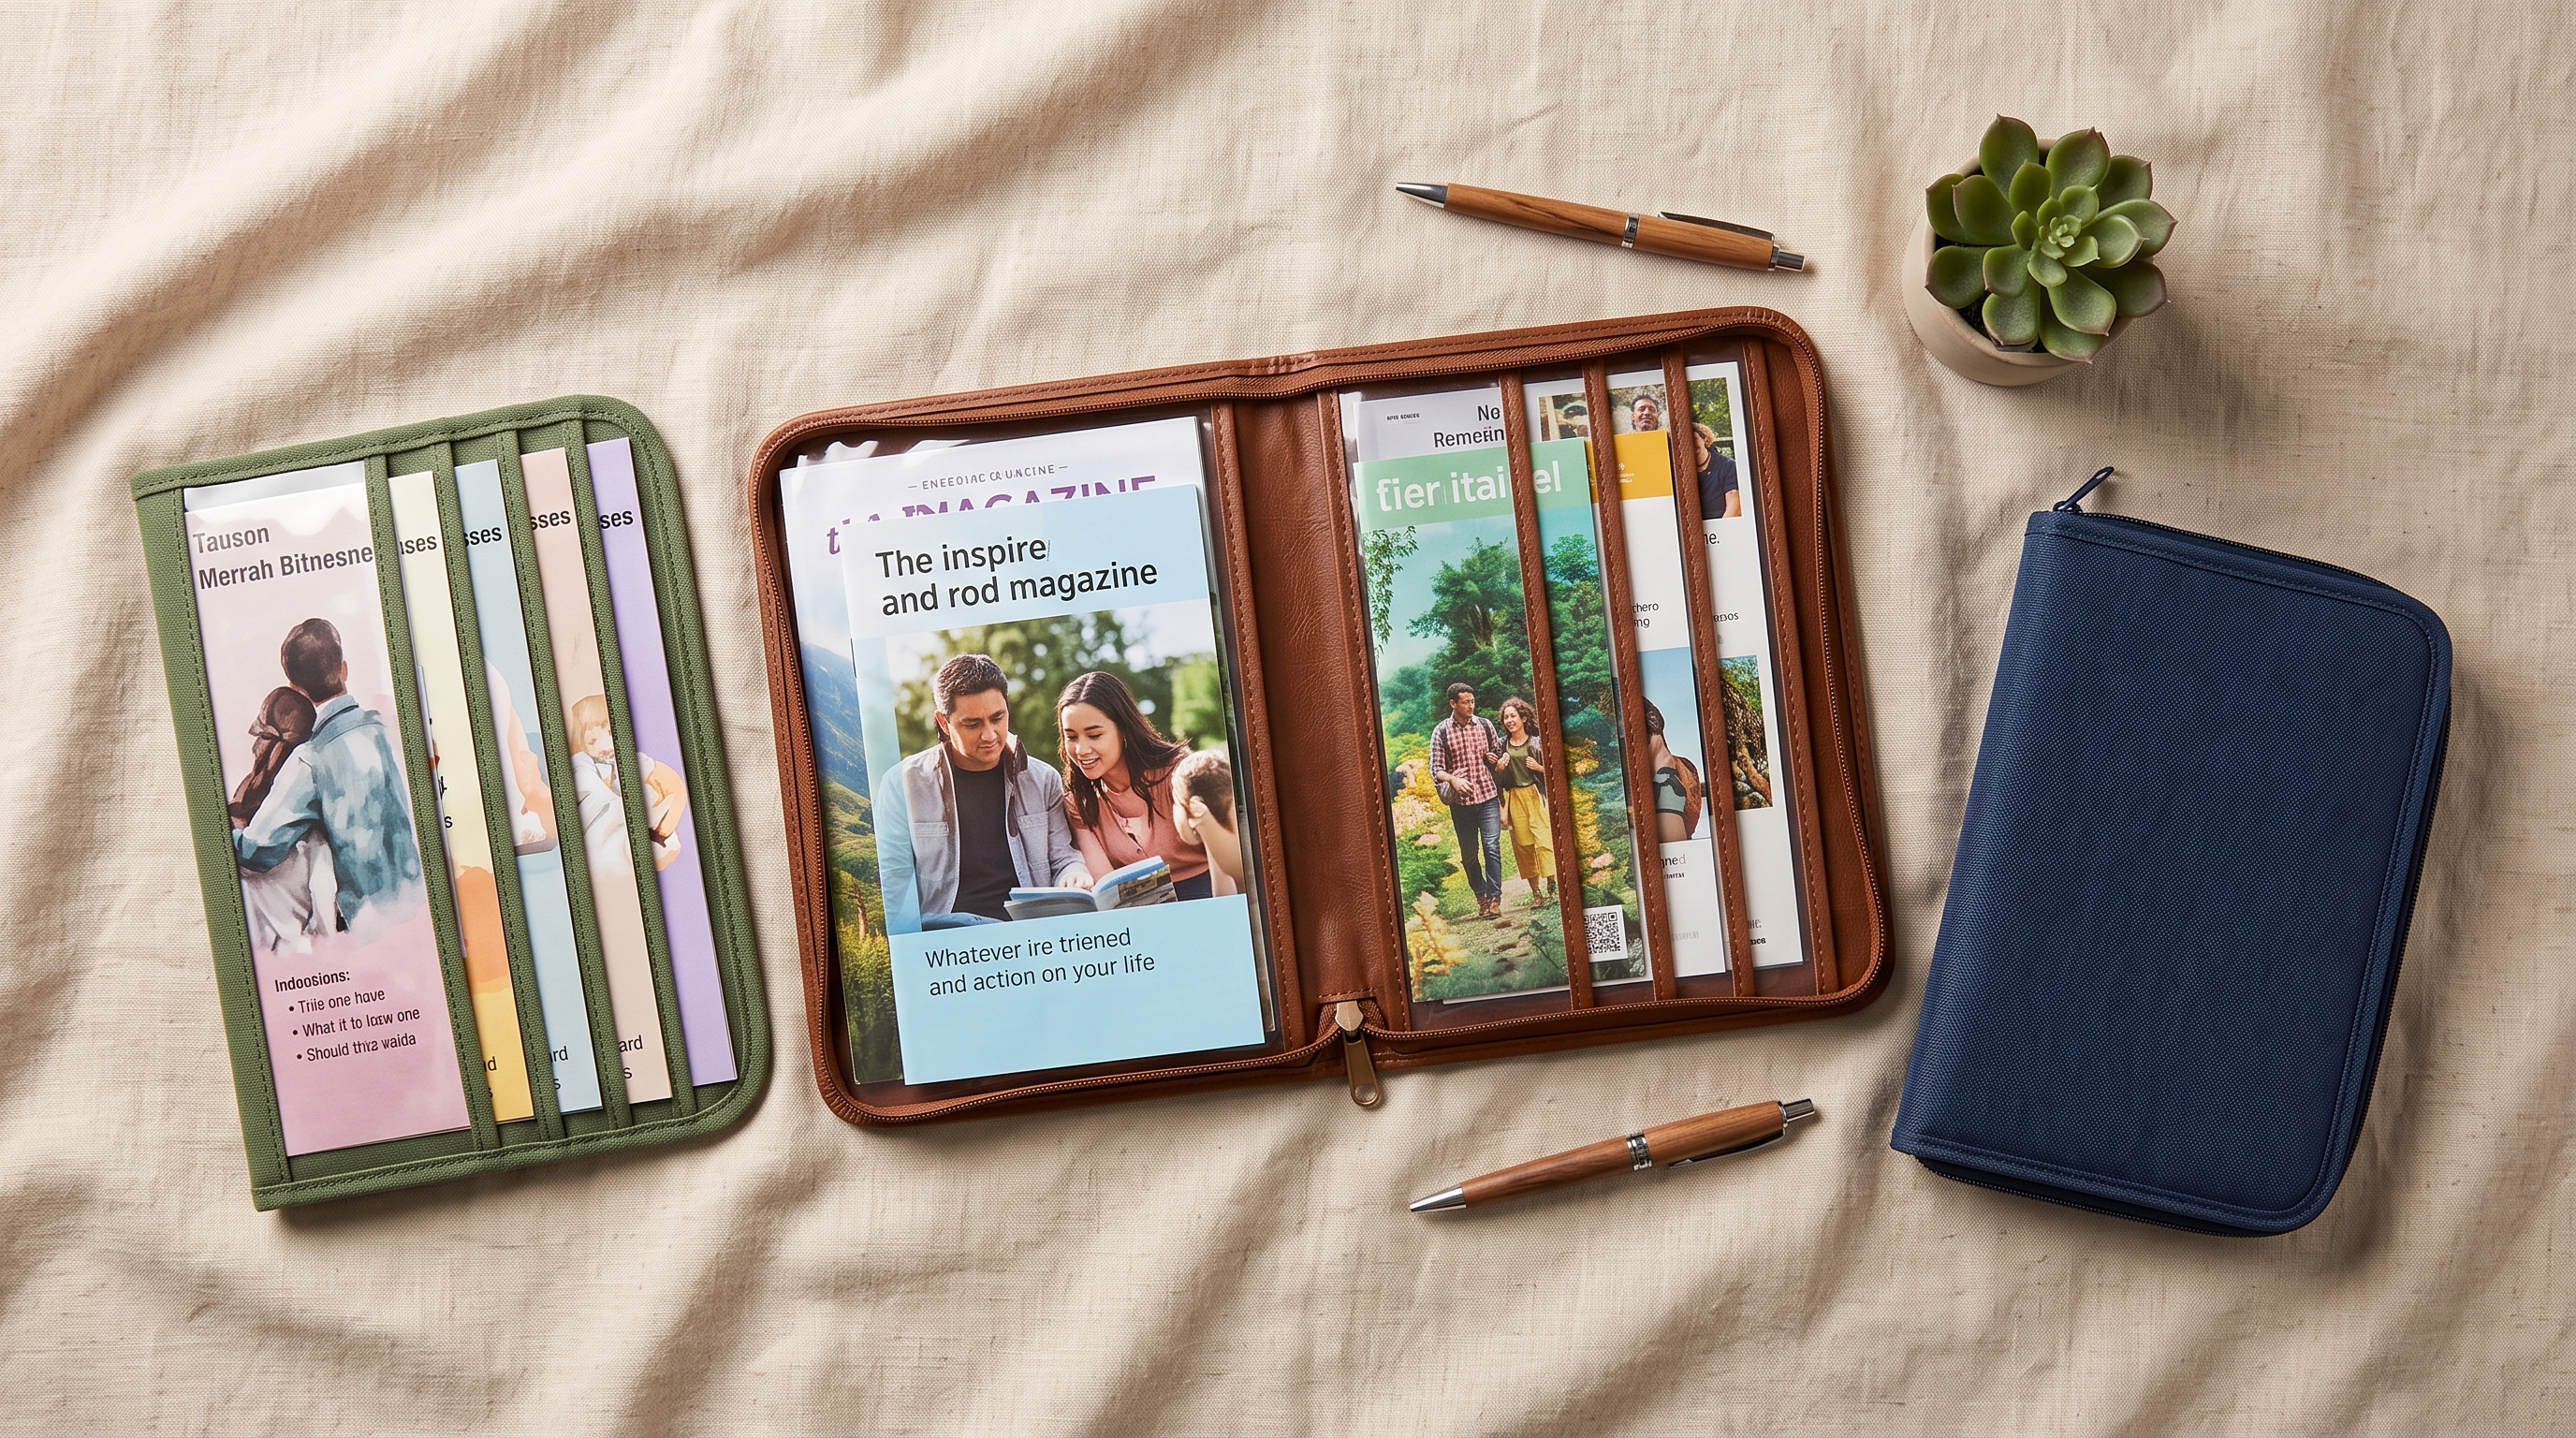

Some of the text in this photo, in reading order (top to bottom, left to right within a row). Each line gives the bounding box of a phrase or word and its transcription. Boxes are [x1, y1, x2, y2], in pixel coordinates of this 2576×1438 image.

[1477, 404, 1500, 421] Ne
[193, 525, 270, 554] Tauson
[198, 546, 373, 590] Merrah Bitnesne
[875, 536, 1047, 580] The inspire
[881, 561, 1158, 616] and rod magazine
[925, 927, 1131, 968] Whatever ire triened
[929, 953, 1155, 996] and action on your life
[329, 995, 351, 1009] one
[355, 990, 385, 1005] have
[302, 1020, 334, 1037] What
[339, 1019, 347, 1031] it
[350, 1017, 362, 1029] to
[397, 1008, 420, 1022] one
[307, 1043, 349, 1061] Should
